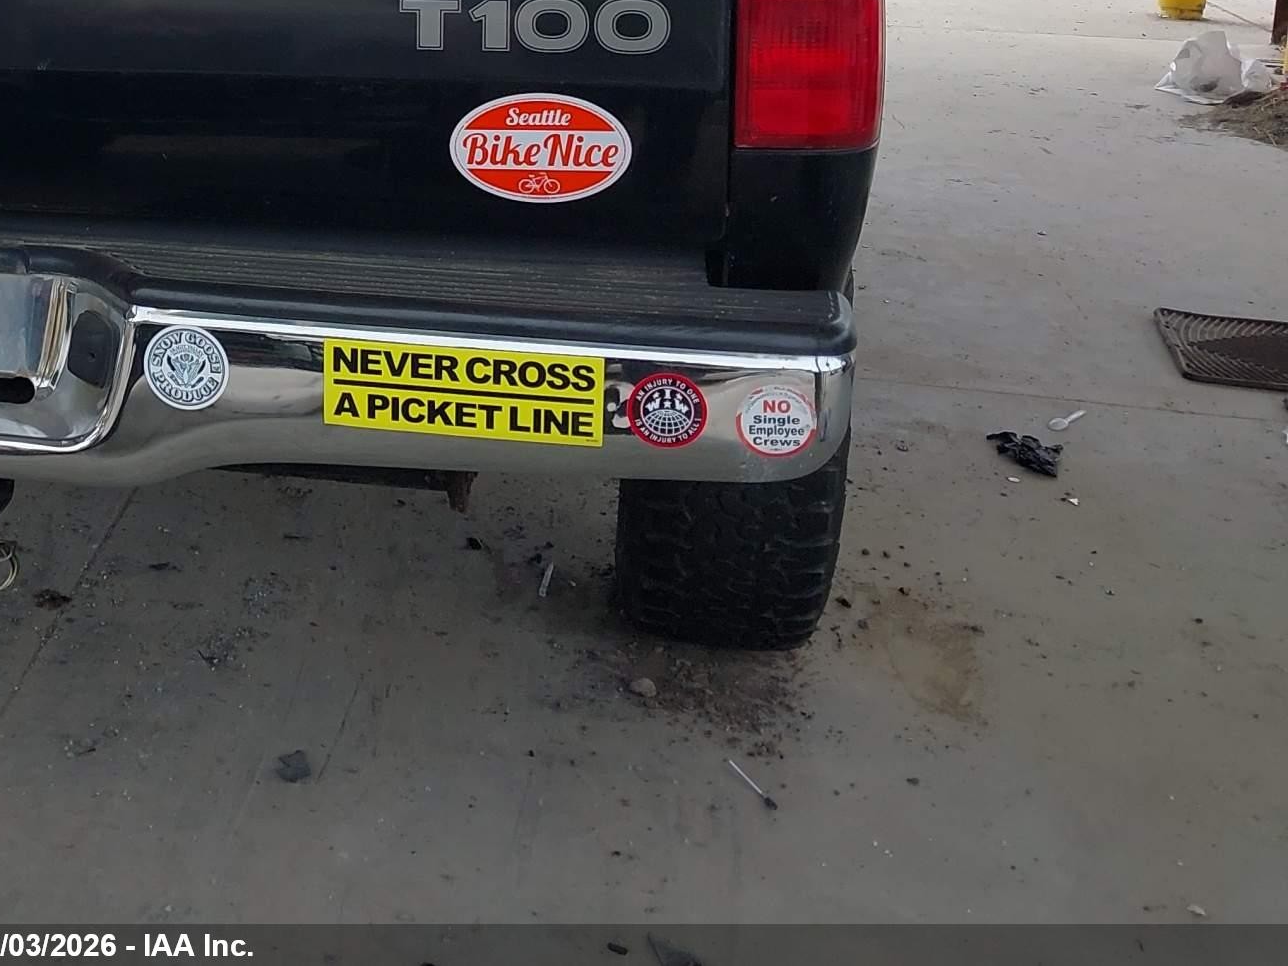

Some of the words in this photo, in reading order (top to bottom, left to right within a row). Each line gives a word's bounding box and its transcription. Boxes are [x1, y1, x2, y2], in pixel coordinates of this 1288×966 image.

[505, 107, 572, 126] Seattle
[463, 133, 541, 166] Bike
[543, 133, 619, 167] Nice
[152, 332, 184, 367] SNOW
[185, 332, 222, 374] GOOSE
[333, 346, 460, 382] NEVER
[465, 357, 596, 392] CROSS
[152, 372, 220, 402] PRODUCE
[635, 389, 646, 401] AN
[644, 378, 673, 392] INJURY
[675, 380, 686, 390] TO
[686, 388, 700, 404] ONE
[333, 392, 360, 418] A
[367, 394, 503, 430] PICKET
[509, 406, 594, 438] LINE
[763, 400, 791, 413] NO
[634, 418, 643, 427] IS
[640, 426, 650, 436] AN
[649, 433, 677, 443] INJURY
[677, 433, 689, 442] TO
[749, 425, 805, 438] Employee
[753, 415, 800, 427] Single
[753, 437, 801, 447] Crews
